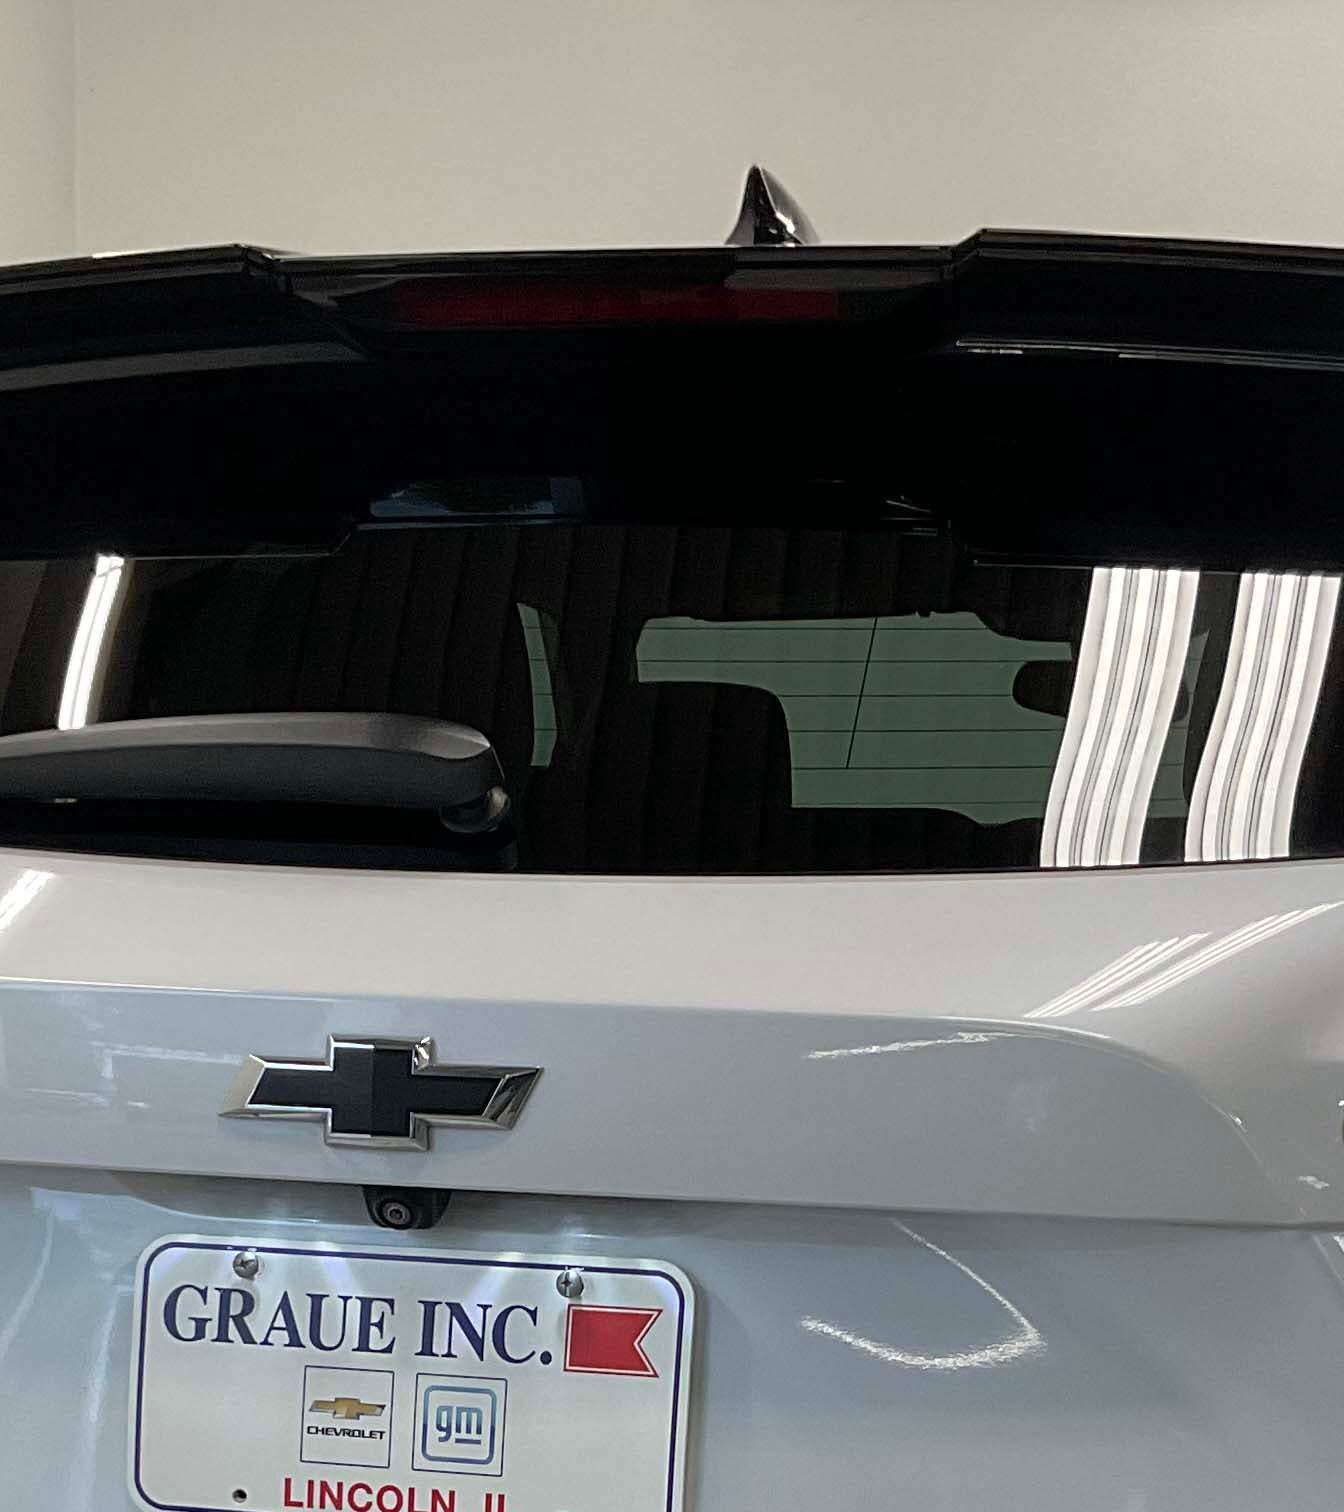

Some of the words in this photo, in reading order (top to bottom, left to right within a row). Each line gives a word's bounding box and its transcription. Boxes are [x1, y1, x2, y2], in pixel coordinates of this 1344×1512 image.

[162, 1284, 397, 1356] GRAUE
[413, 1299, 554, 1366] INC.
[306, 1425, 386, 1441] CHEVROLET
[435, 1405, 484, 1446] gm
